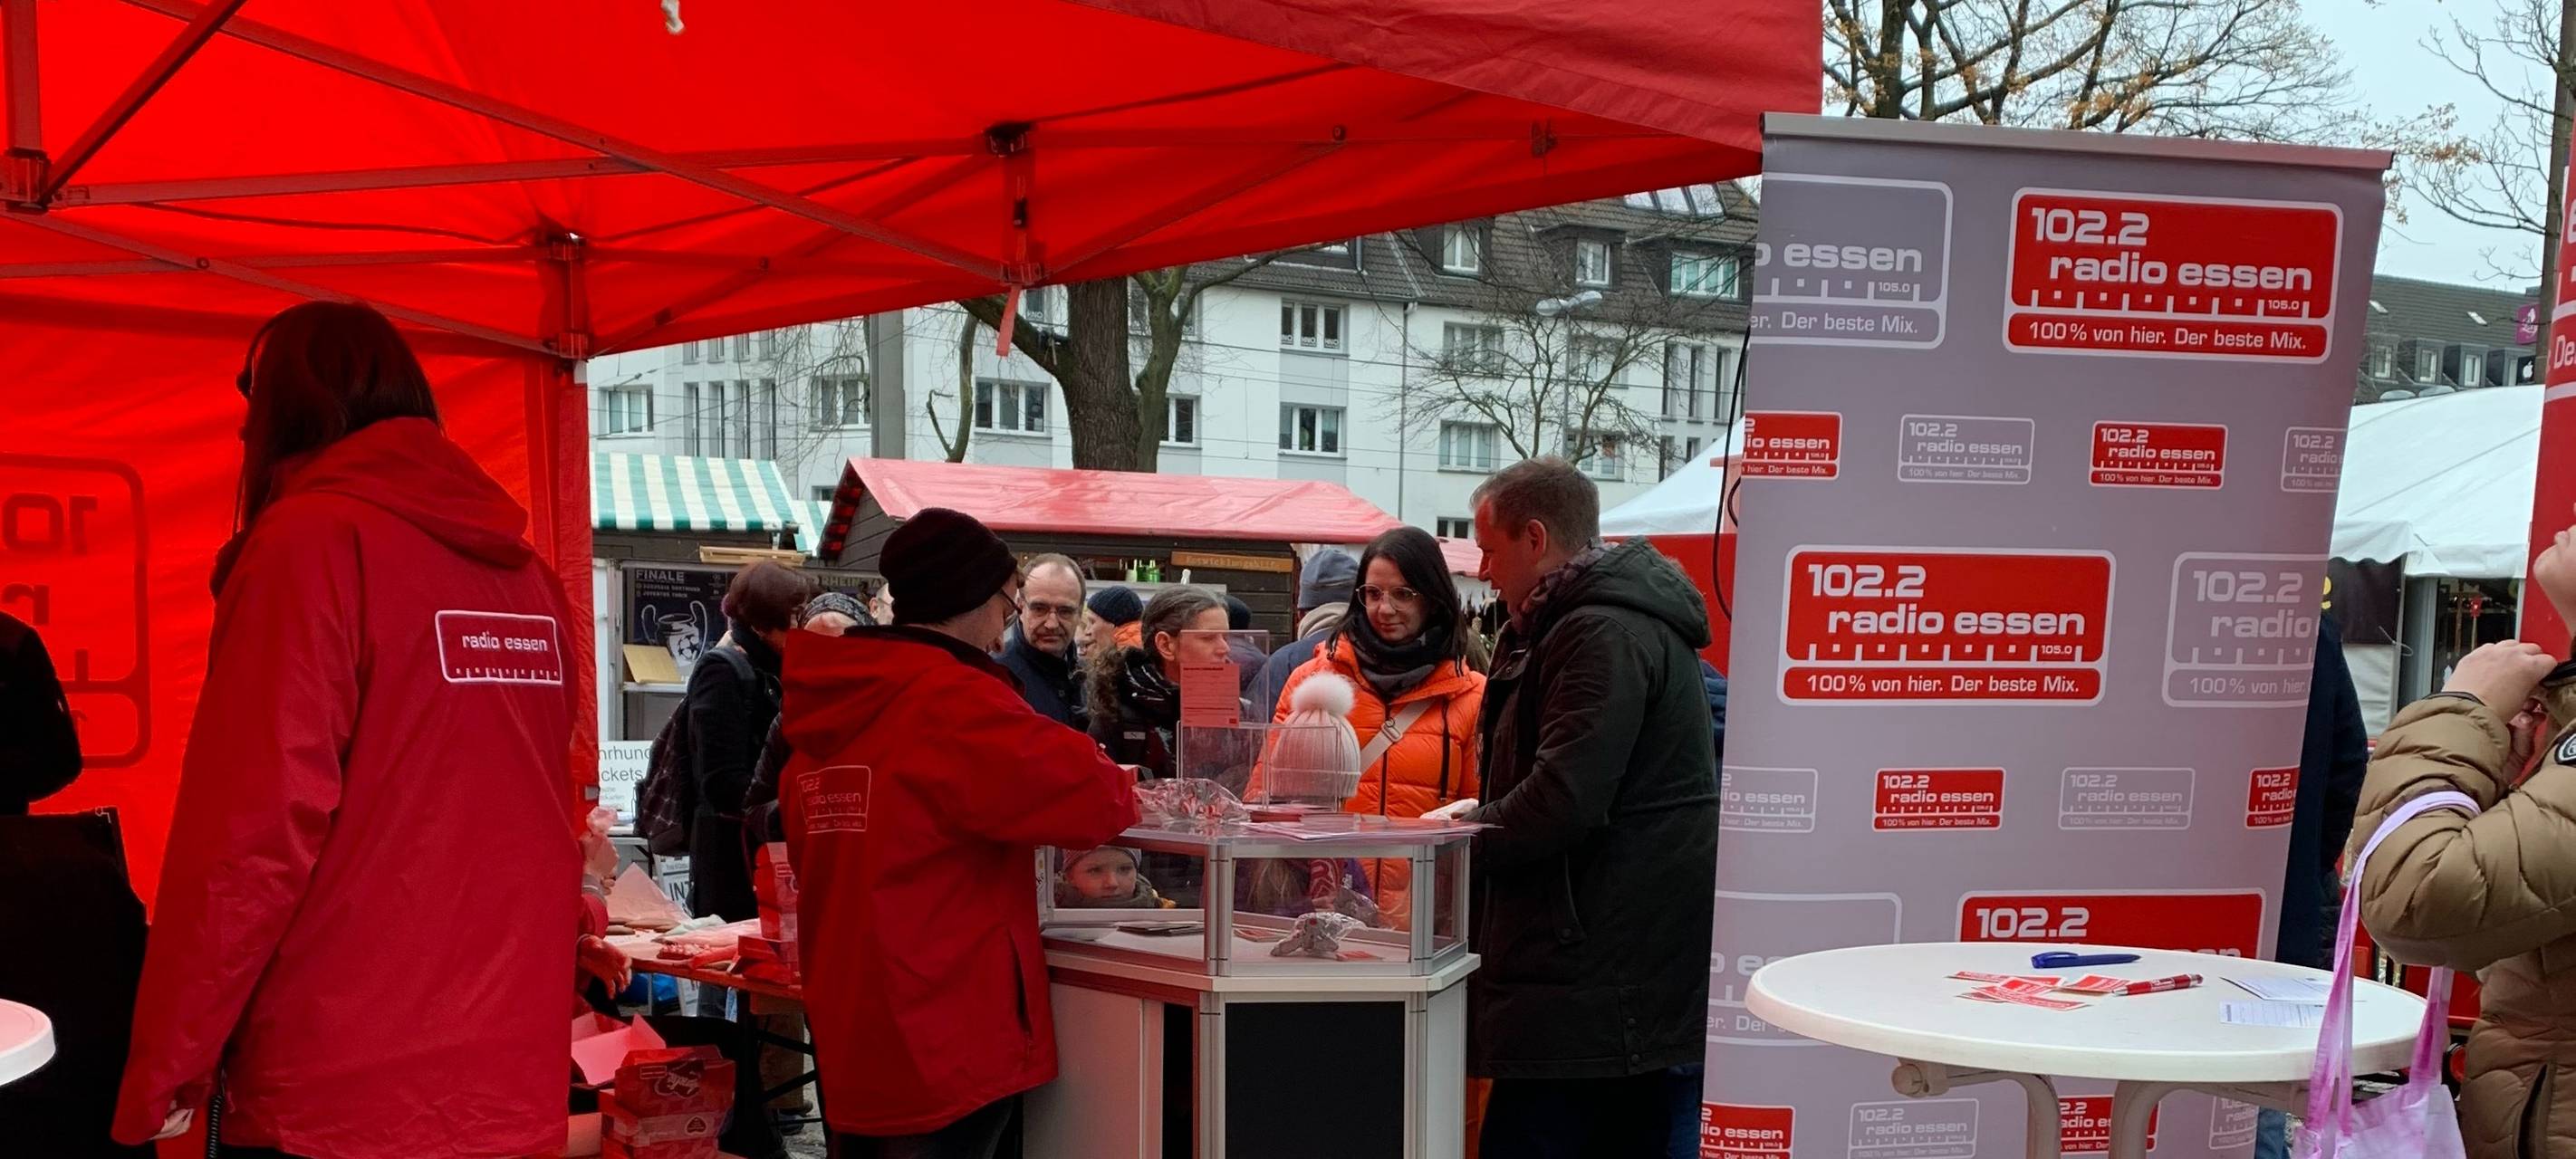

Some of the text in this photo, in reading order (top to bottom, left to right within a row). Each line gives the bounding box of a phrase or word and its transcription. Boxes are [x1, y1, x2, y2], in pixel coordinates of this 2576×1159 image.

[2032, 206, 2149, 246] 102.2
[1783, 243, 1922, 272] essen
[2049, 252, 2312, 291] radio essen
[1878, 282, 1910, 292] 105.0
[2267, 299, 2300, 311] 105.0
[1782, 311, 1817, 330] Der
[1824, 312, 1875, 331] beste
[1881, 315, 1918, 334] Mix.
[2093, 326, 2124, 342] von
[2130, 326, 2167, 344] hier.
[2175, 328, 2207, 346] Der
[2214, 330, 2264, 348] beste
[2270, 330, 2306, 350] Mix.
[2553, 334, 2576, 369] De
[1909, 422, 1957, 437] 102.2
[2100, 427, 2149, 443] 102.2
[1769, 437, 1830, 449] essen
[1917, 439, 2023, 455] radio essen
[2292, 435, 2334, 449] 102.2
[2108, 445, 2216, 460] radio essen
[2300, 451, 2338, 464] radio
[636, 569, 685, 582] FINALE
[1808, 563, 1927, 598] 102.2
[2193, 570, 2303, 603] 102.2
[1828, 603, 2085, 635] radio essen
[2210, 609, 2312, 638] radio
[462, 630, 549, 651] radio essen
[2041, 645, 2073, 655] 105.0
[1871, 678, 1901, 692] von
[1908, 675, 1943, 693] hier.
[1951, 675, 1983, 693] Der
[1989, 675, 2037, 693] beste
[2043, 675, 2079, 693] Mix.
[2251, 680, 2278, 694] von
[1883, 775, 1930, 789] 102.2
[2070, 774, 2118, 788] 102.2
[2256, 773, 2291, 788] 102.2
[827, 792, 861, 803] essen
[1745, 792, 1805, 804] essen
[1890, 790, 1994, 803] radio essen
[2077, 790, 2182, 802] radio essen
[2262, 788, 2292, 801] radio
[1975, 907, 2090, 938] 102.2
[1859, 1107, 1904, 1123] 102.2
[1725, 1127, 1783, 1139] essen
[1866, 1122, 1967, 1135] radio essen
